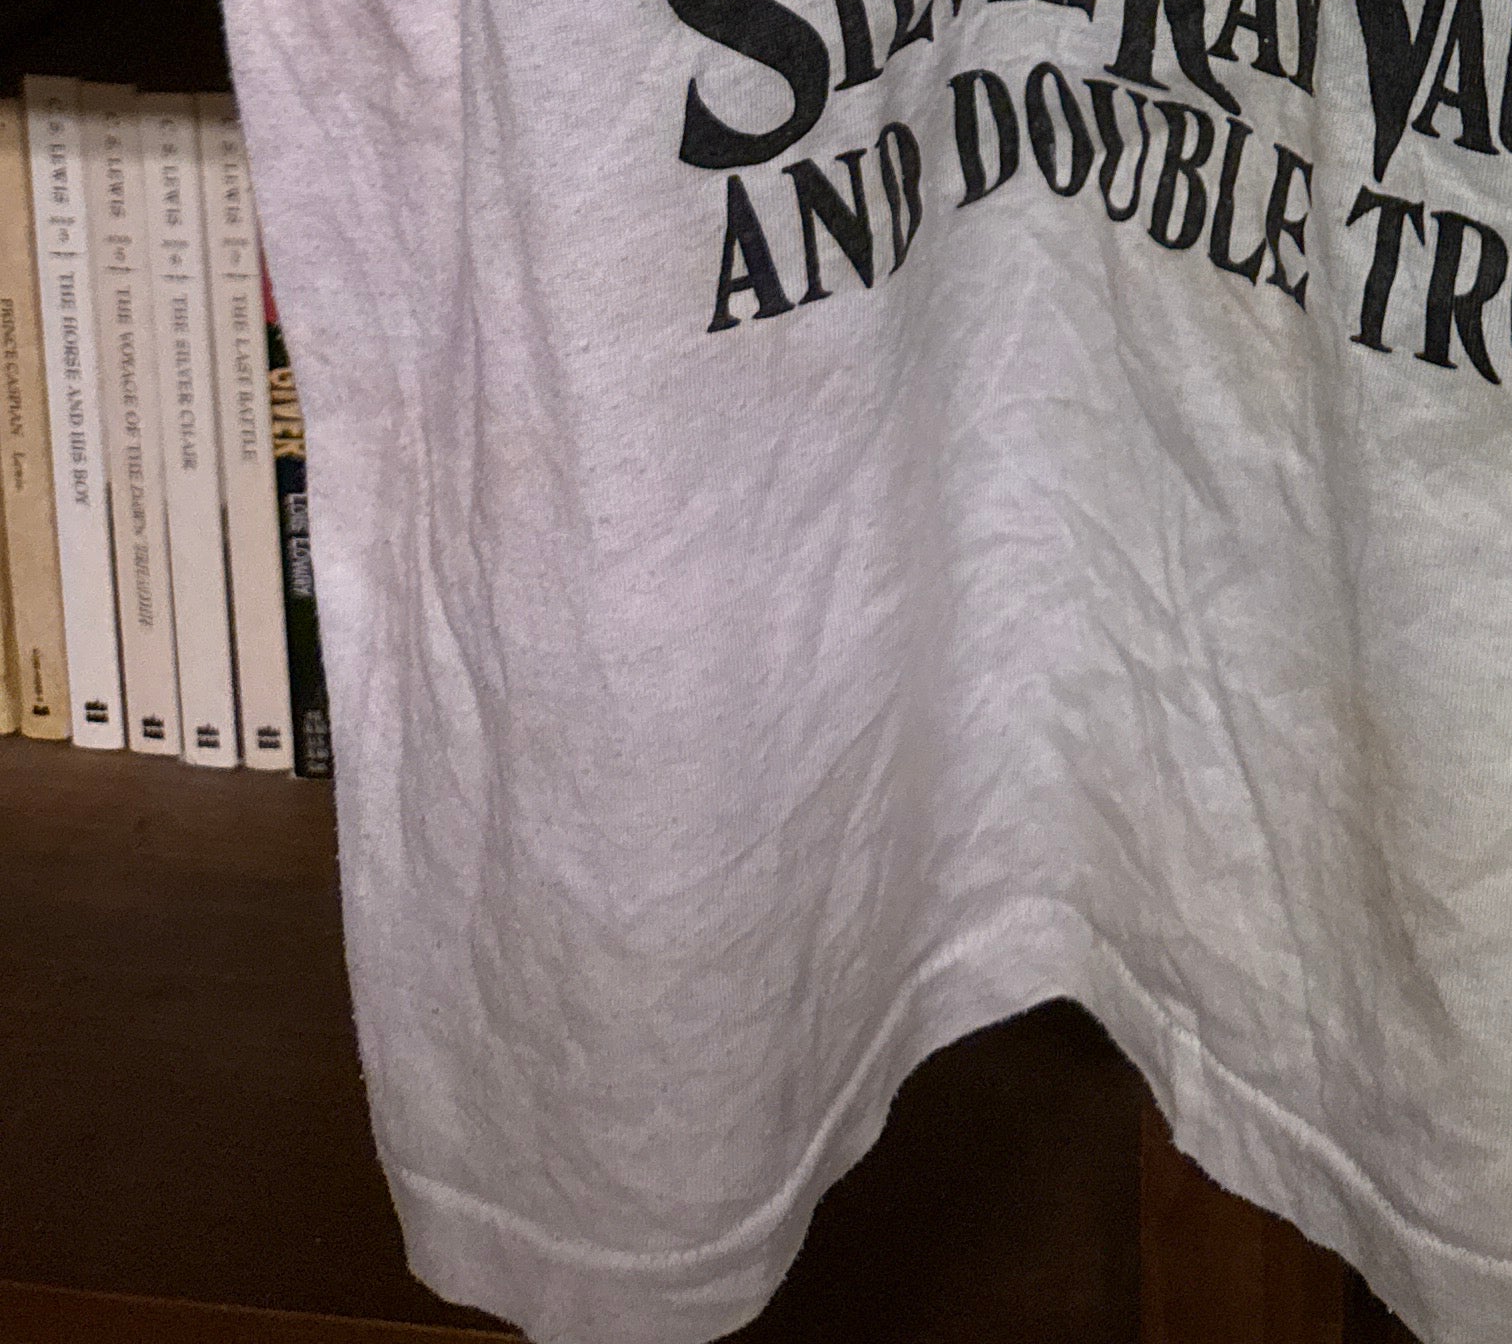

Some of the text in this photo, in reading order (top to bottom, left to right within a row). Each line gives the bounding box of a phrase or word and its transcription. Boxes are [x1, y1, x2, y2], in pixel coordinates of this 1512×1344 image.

[706, 120, 923, 333] AND
[947, 61, 1315, 313] DOUBLE
[60, 270, 90, 507] THE HORSE AND HIS BOY
[116, 285, 133, 325] THE
[118, 330, 139, 405] VOYAGE
[172, 293, 199, 472] THE SILVER CHAIR
[231, 295, 258, 463] THE LAST BATTLE
[126, 444, 144, 483] THE
